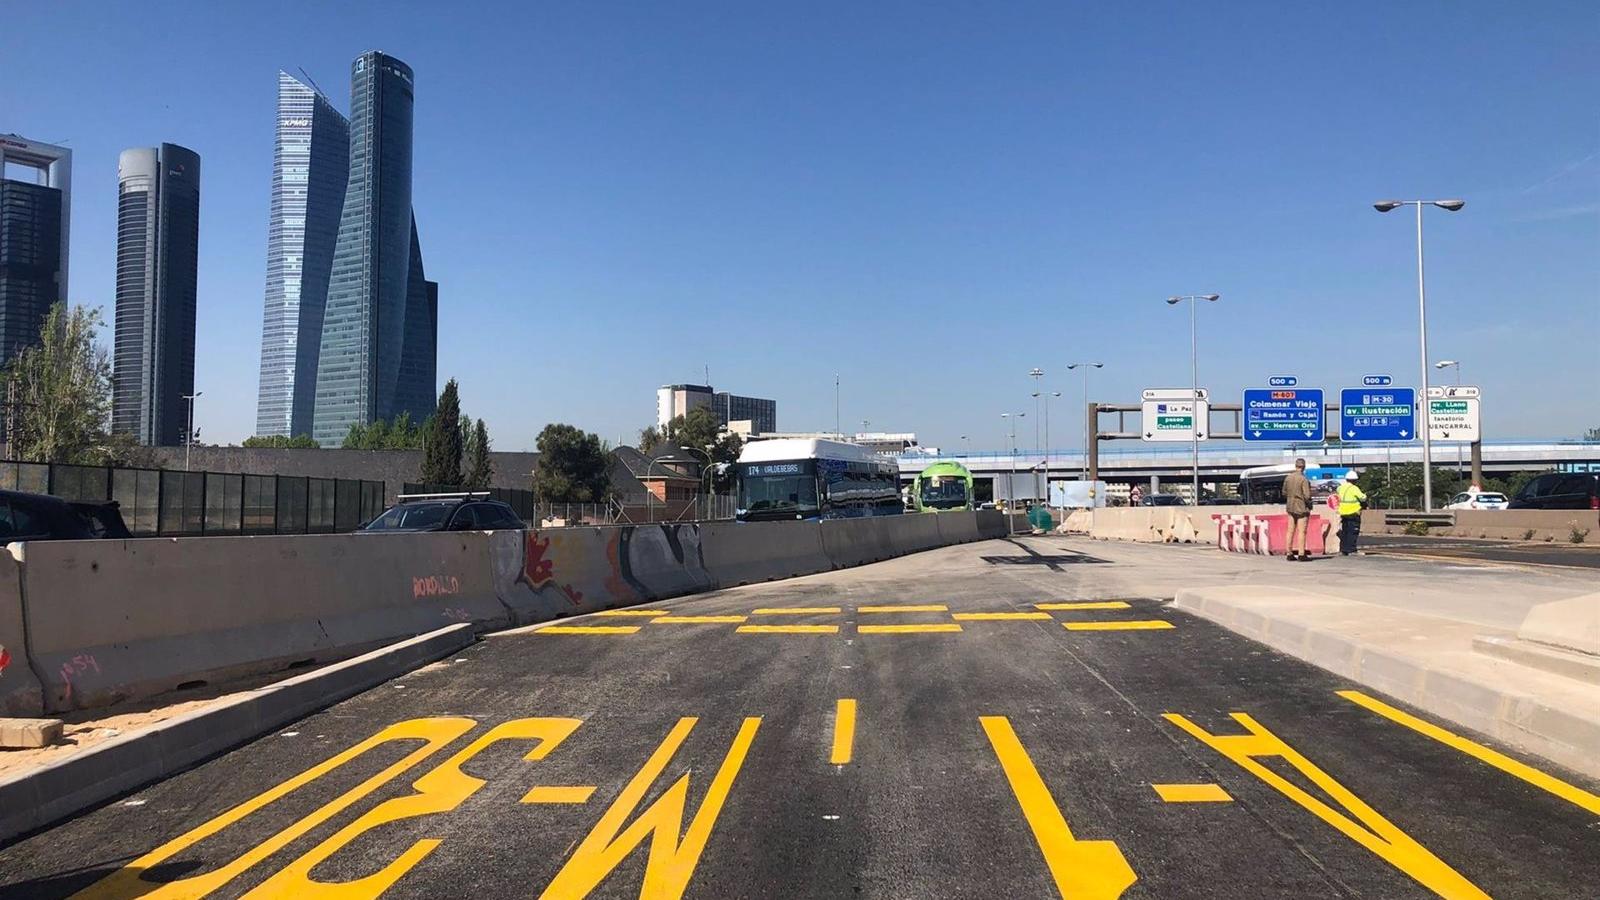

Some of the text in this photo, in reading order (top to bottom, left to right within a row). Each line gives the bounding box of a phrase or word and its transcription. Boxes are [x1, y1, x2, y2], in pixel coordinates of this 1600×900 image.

[283, 119, 308, 127] KPMG
[1250, 400, 1317, 409] Colmenar Viejo
[1361, 406, 1409, 414] Ilustración
[1298, 411, 1317, 419] Cajal
[748, 465, 760, 476] 174
